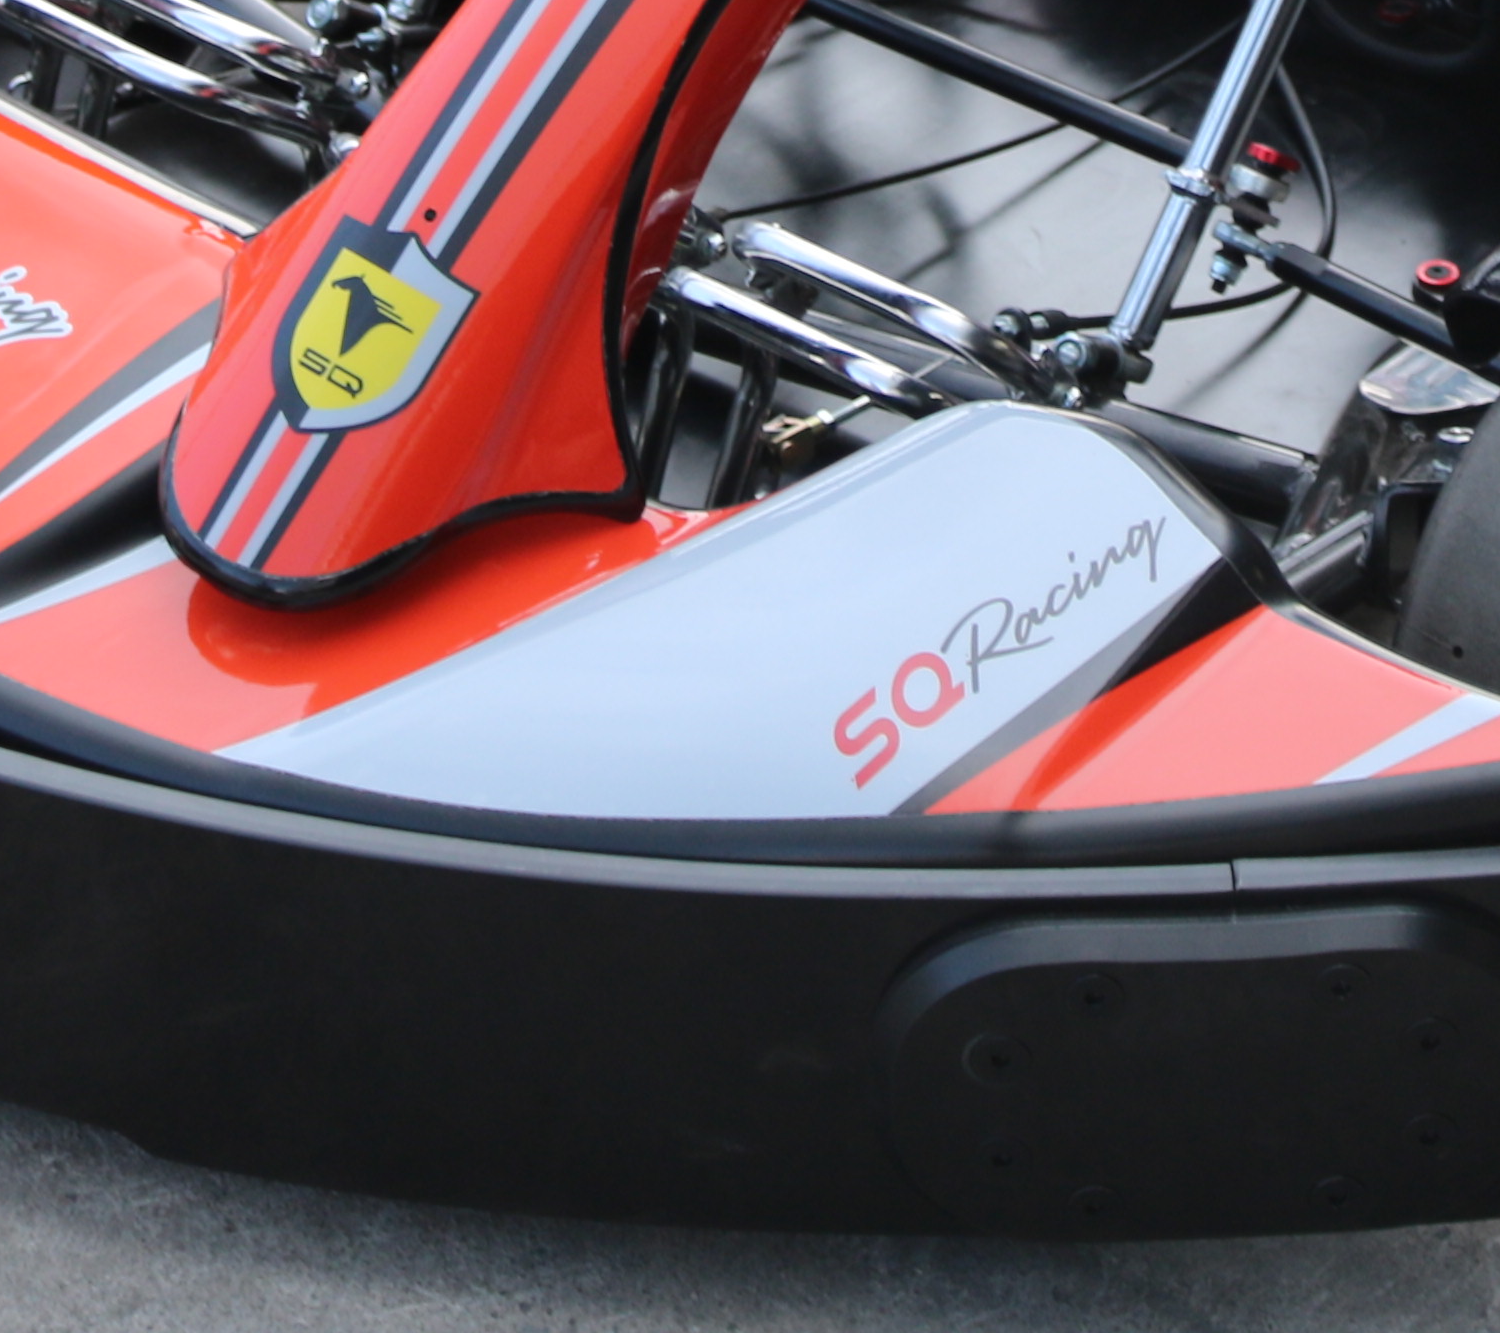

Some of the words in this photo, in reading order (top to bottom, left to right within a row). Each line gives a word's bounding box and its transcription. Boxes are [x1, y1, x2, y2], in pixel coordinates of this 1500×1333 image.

[298, 347, 364, 398] SQ
[832, 651, 966, 790] SQ
[940, 516, 1166, 694] Racing
